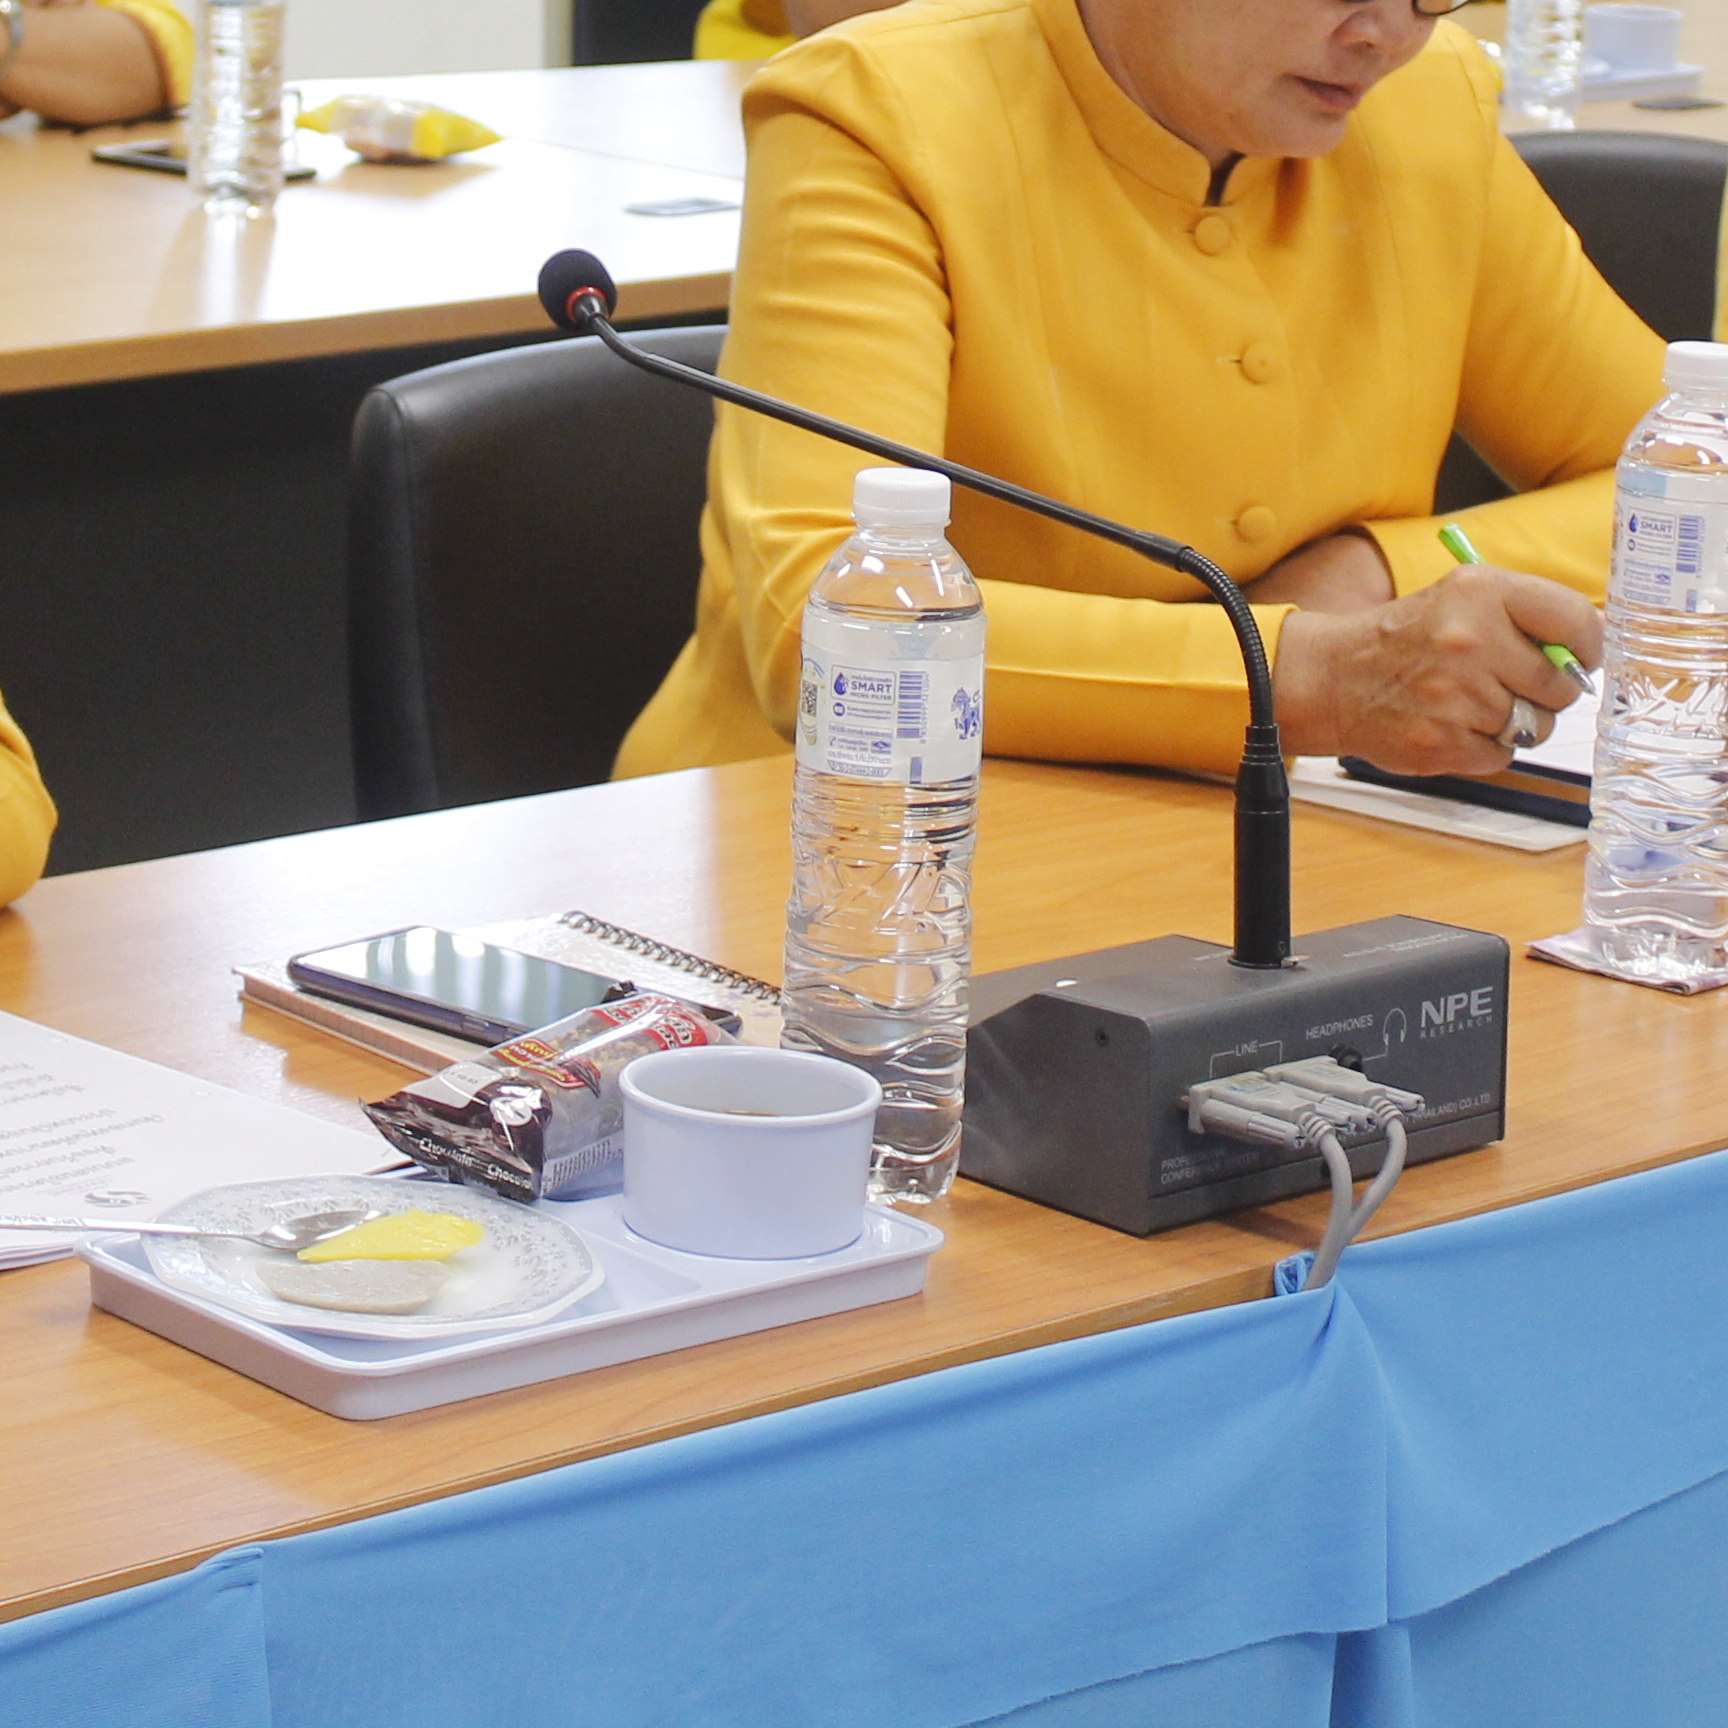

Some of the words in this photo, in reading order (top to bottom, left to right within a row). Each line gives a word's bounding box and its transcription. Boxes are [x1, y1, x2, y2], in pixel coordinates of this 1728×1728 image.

[1640, 520, 1673, 533] SMART
[851, 681, 893, 694] SMART
[1420, 986, 1494, 1029] NPE
[1306, 1014, 1374, 1040] HEADPHONES
[1420, 1015, 1493, 1040] RESEARCH
[1235, 1040, 1259, 1057] LINE
